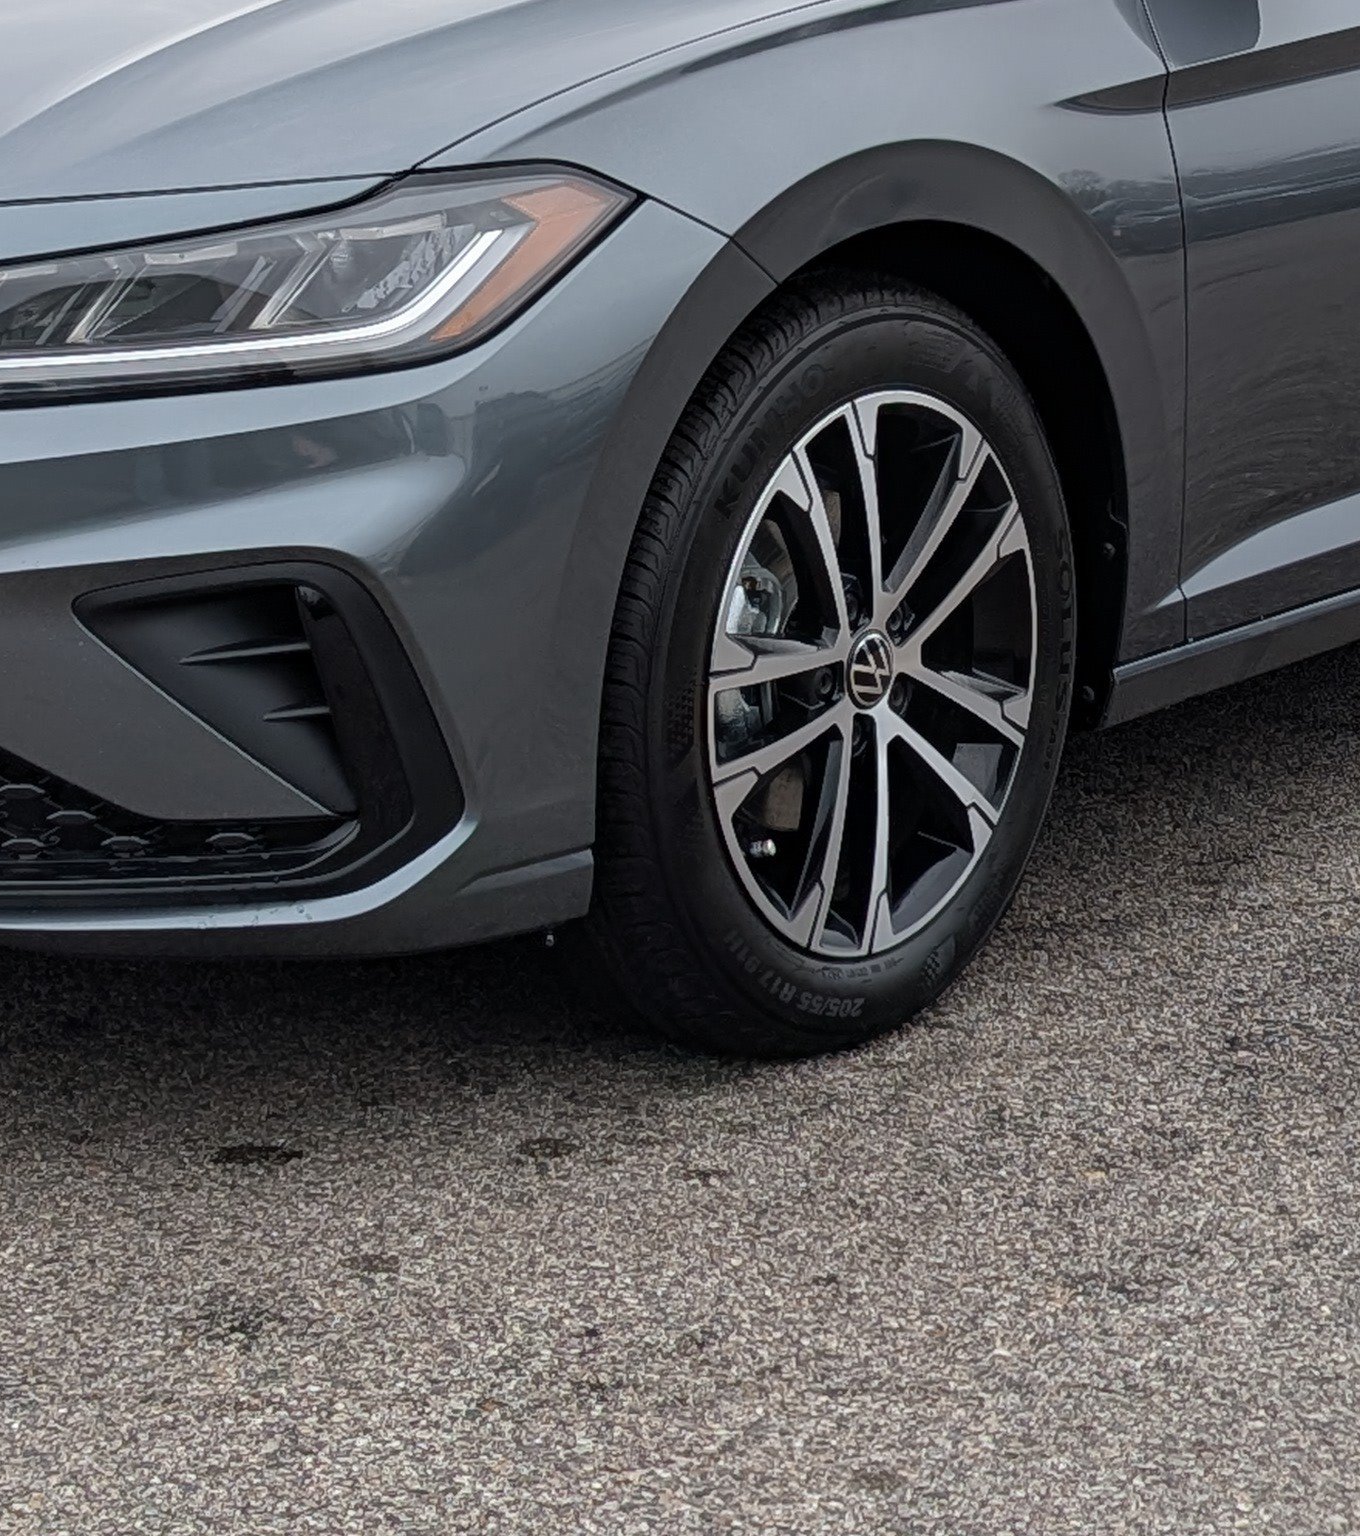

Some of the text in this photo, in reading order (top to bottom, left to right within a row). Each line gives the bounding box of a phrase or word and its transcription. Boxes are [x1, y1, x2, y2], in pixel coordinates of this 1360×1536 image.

[1053, 526, 1074, 713] SOLUS
[760, 969, 797, 1004] R17
[795, 990, 866, 1019] 205/55
